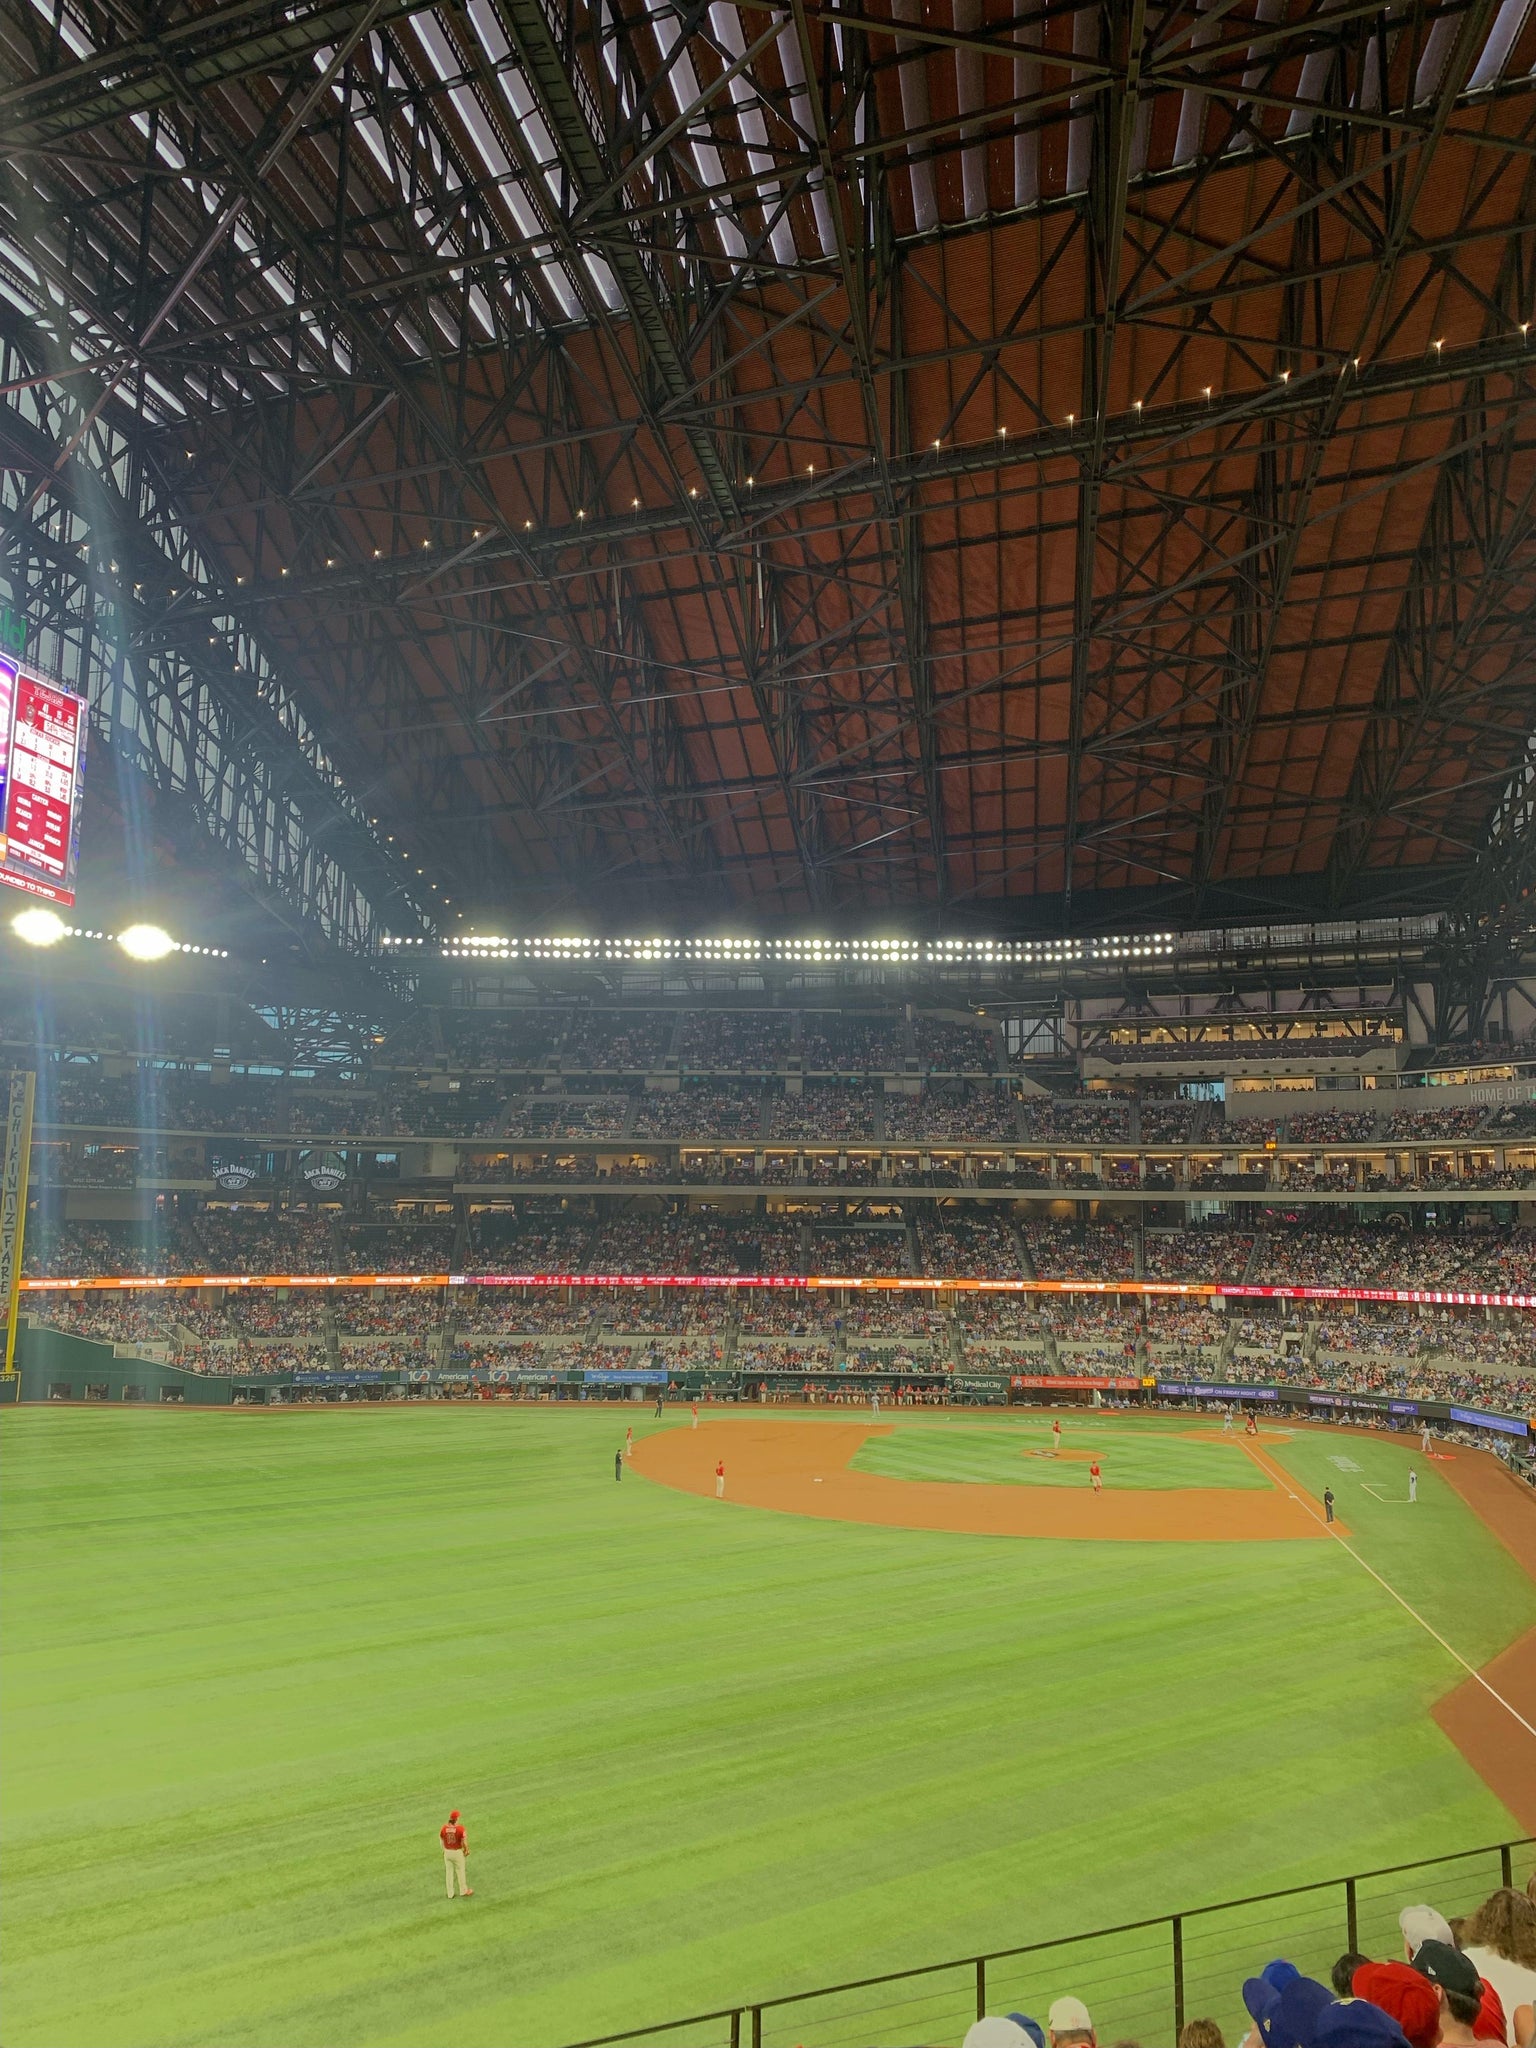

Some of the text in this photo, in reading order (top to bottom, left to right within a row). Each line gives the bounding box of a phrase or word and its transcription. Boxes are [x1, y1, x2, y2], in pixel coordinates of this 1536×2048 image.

[1470, 1088, 1504, 1102] HOME
[1507, 1086, 1522, 1100] OF
[212, 1166, 230, 1178] JACK
[304, 1168, 320, 1180] JACK
[989, 1381, 1002, 1390] City
